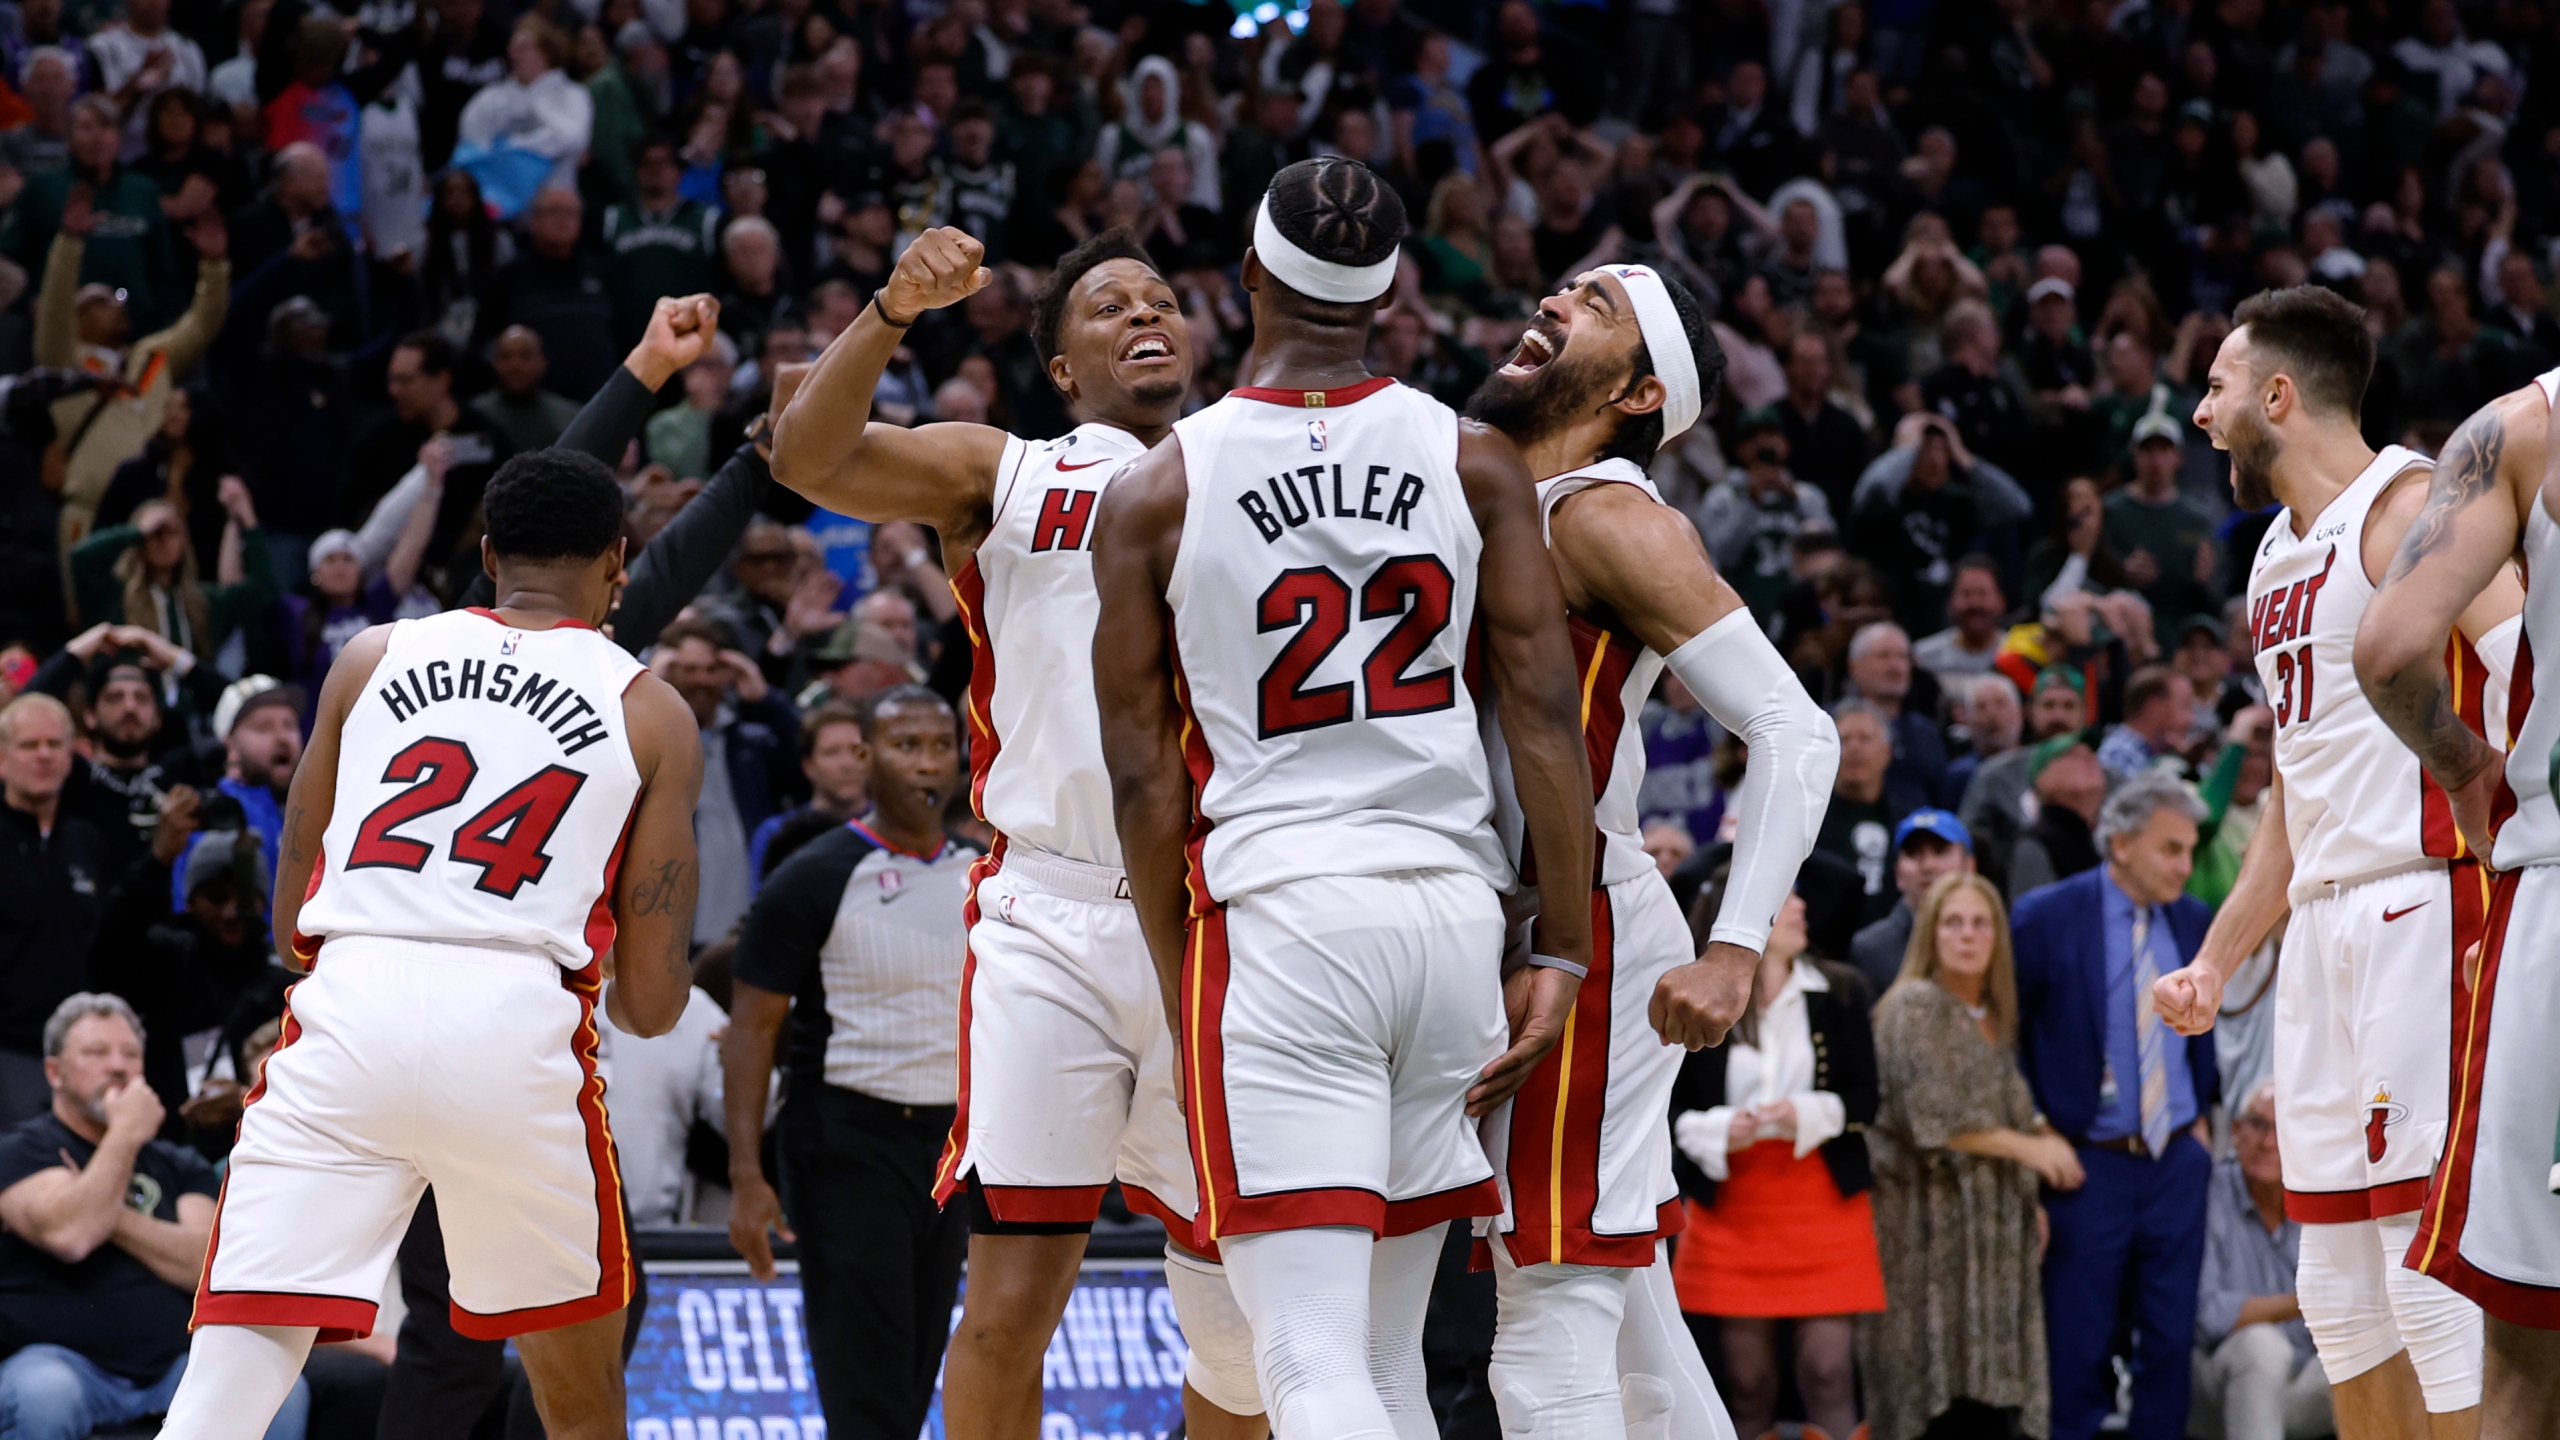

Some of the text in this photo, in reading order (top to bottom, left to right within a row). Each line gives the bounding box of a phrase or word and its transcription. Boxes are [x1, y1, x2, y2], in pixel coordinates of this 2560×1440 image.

[1237, 464, 1425, 544] BUTLER
[2316, 522, 2346, 541] UKG
[1257, 553, 1456, 741] 22
[2251, 543, 2336, 657] HEAT
[379, 658, 609, 757] HIGHSMITH
[2276, 643, 2313, 729] 31
[343, 735, 589, 901] 24
[677, 1287, 1190, 1392] CELT AWKS
